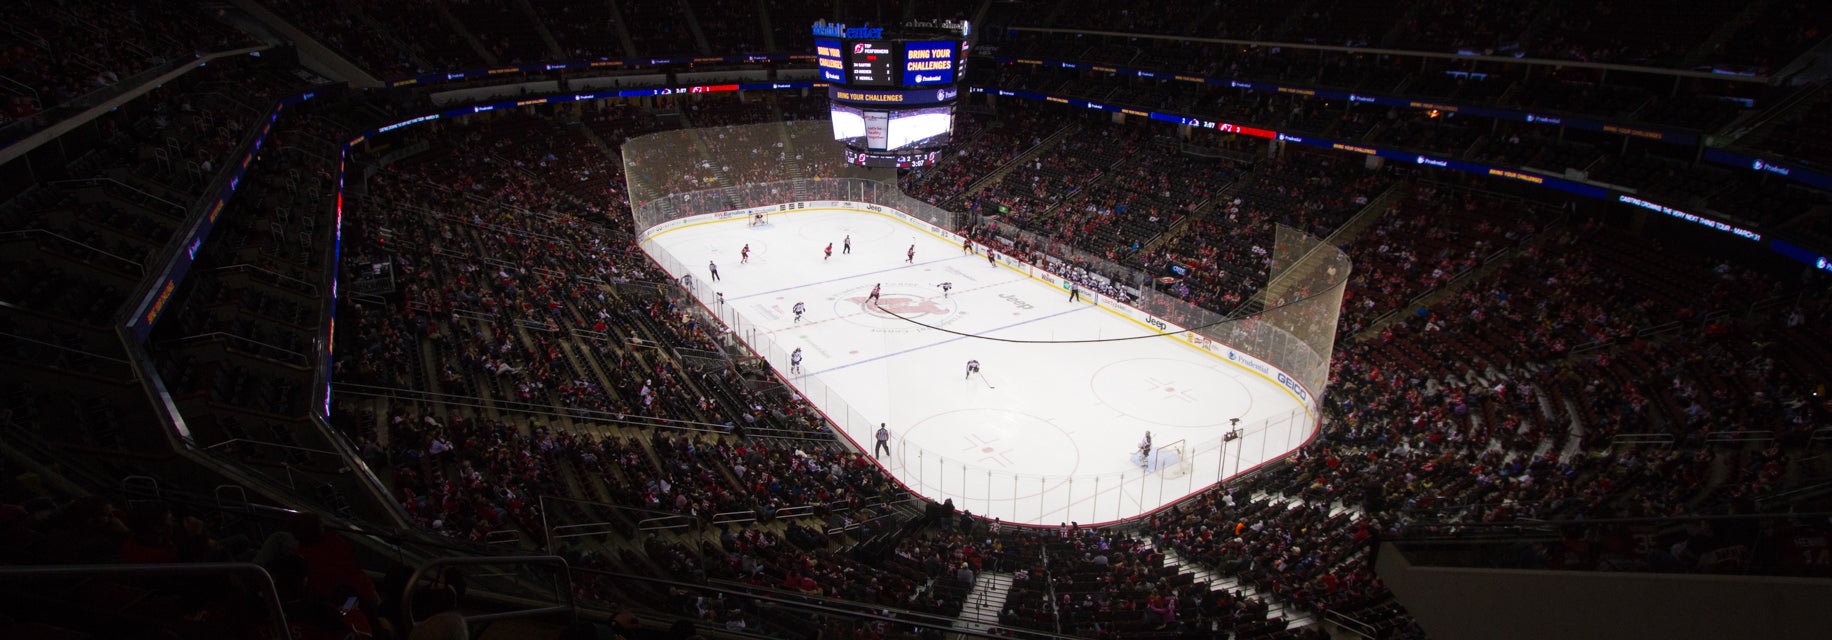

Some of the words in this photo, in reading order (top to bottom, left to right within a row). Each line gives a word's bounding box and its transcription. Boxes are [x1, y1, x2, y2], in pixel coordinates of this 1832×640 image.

[908, 50, 930, 60] BRING
[932, 49, 951, 58] YOUR
[907, 61, 952, 71] CHALLENGES
[866, 204, 882, 212] Jeep
[1685, 214, 1699, 222] NEXT
[1716, 222, 1730, 231] TOUR
[1734, 227, 1754, 238] MARCH
[998, 293, 1034, 310] Jeep
[1146, 315, 1166, 330] Jeep
[1238, 355, 1269, 374] Prudential
[1277, 372, 1307, 401] GEICO
